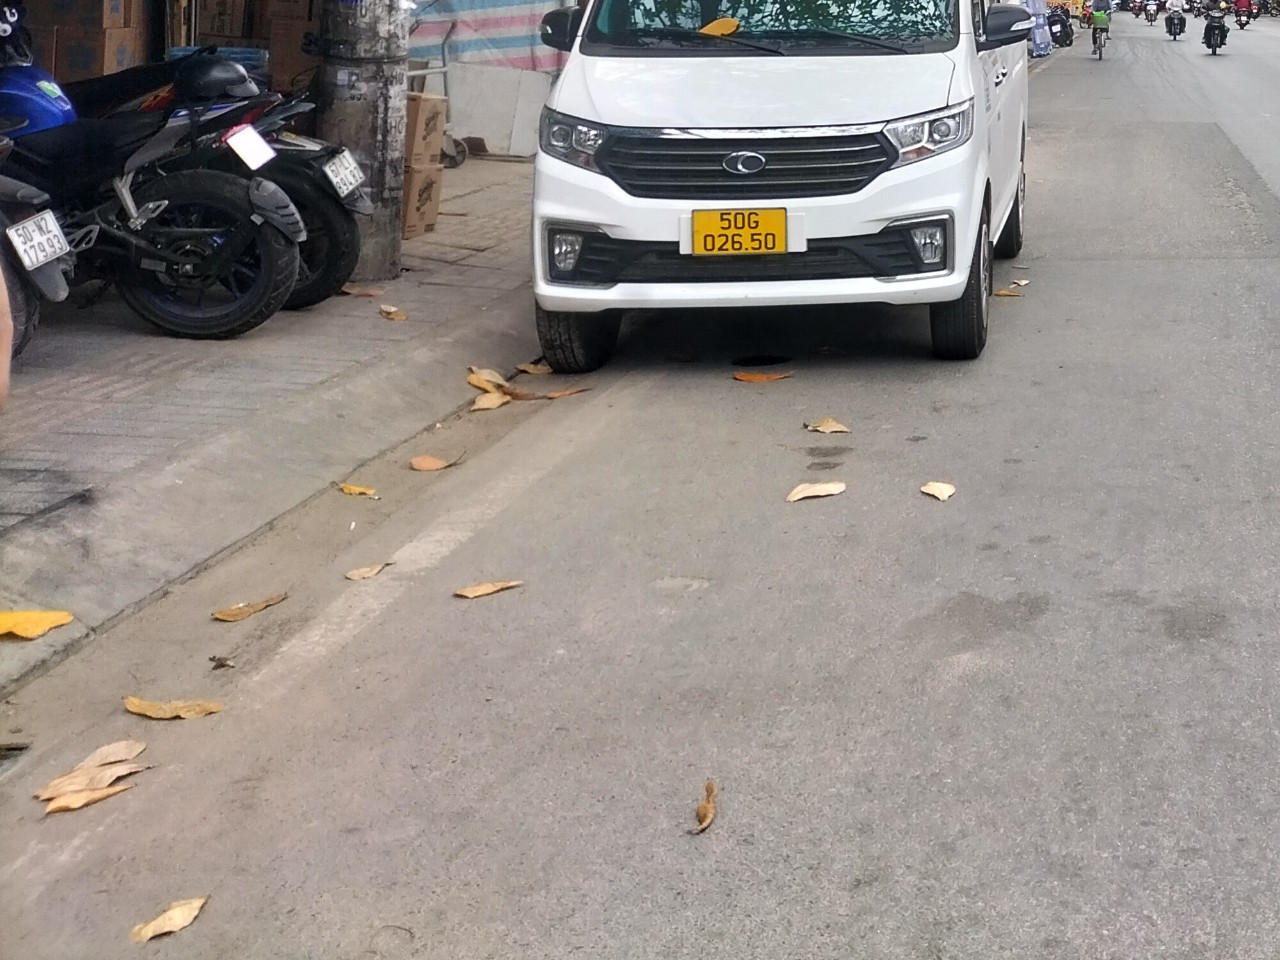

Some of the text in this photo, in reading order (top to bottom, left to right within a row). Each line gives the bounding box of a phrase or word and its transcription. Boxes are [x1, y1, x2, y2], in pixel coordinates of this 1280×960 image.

[720, 212, 759, 230] 50G
[14, 216, 54, 246] 50-N2
[703, 233, 776, 252] 026.50
